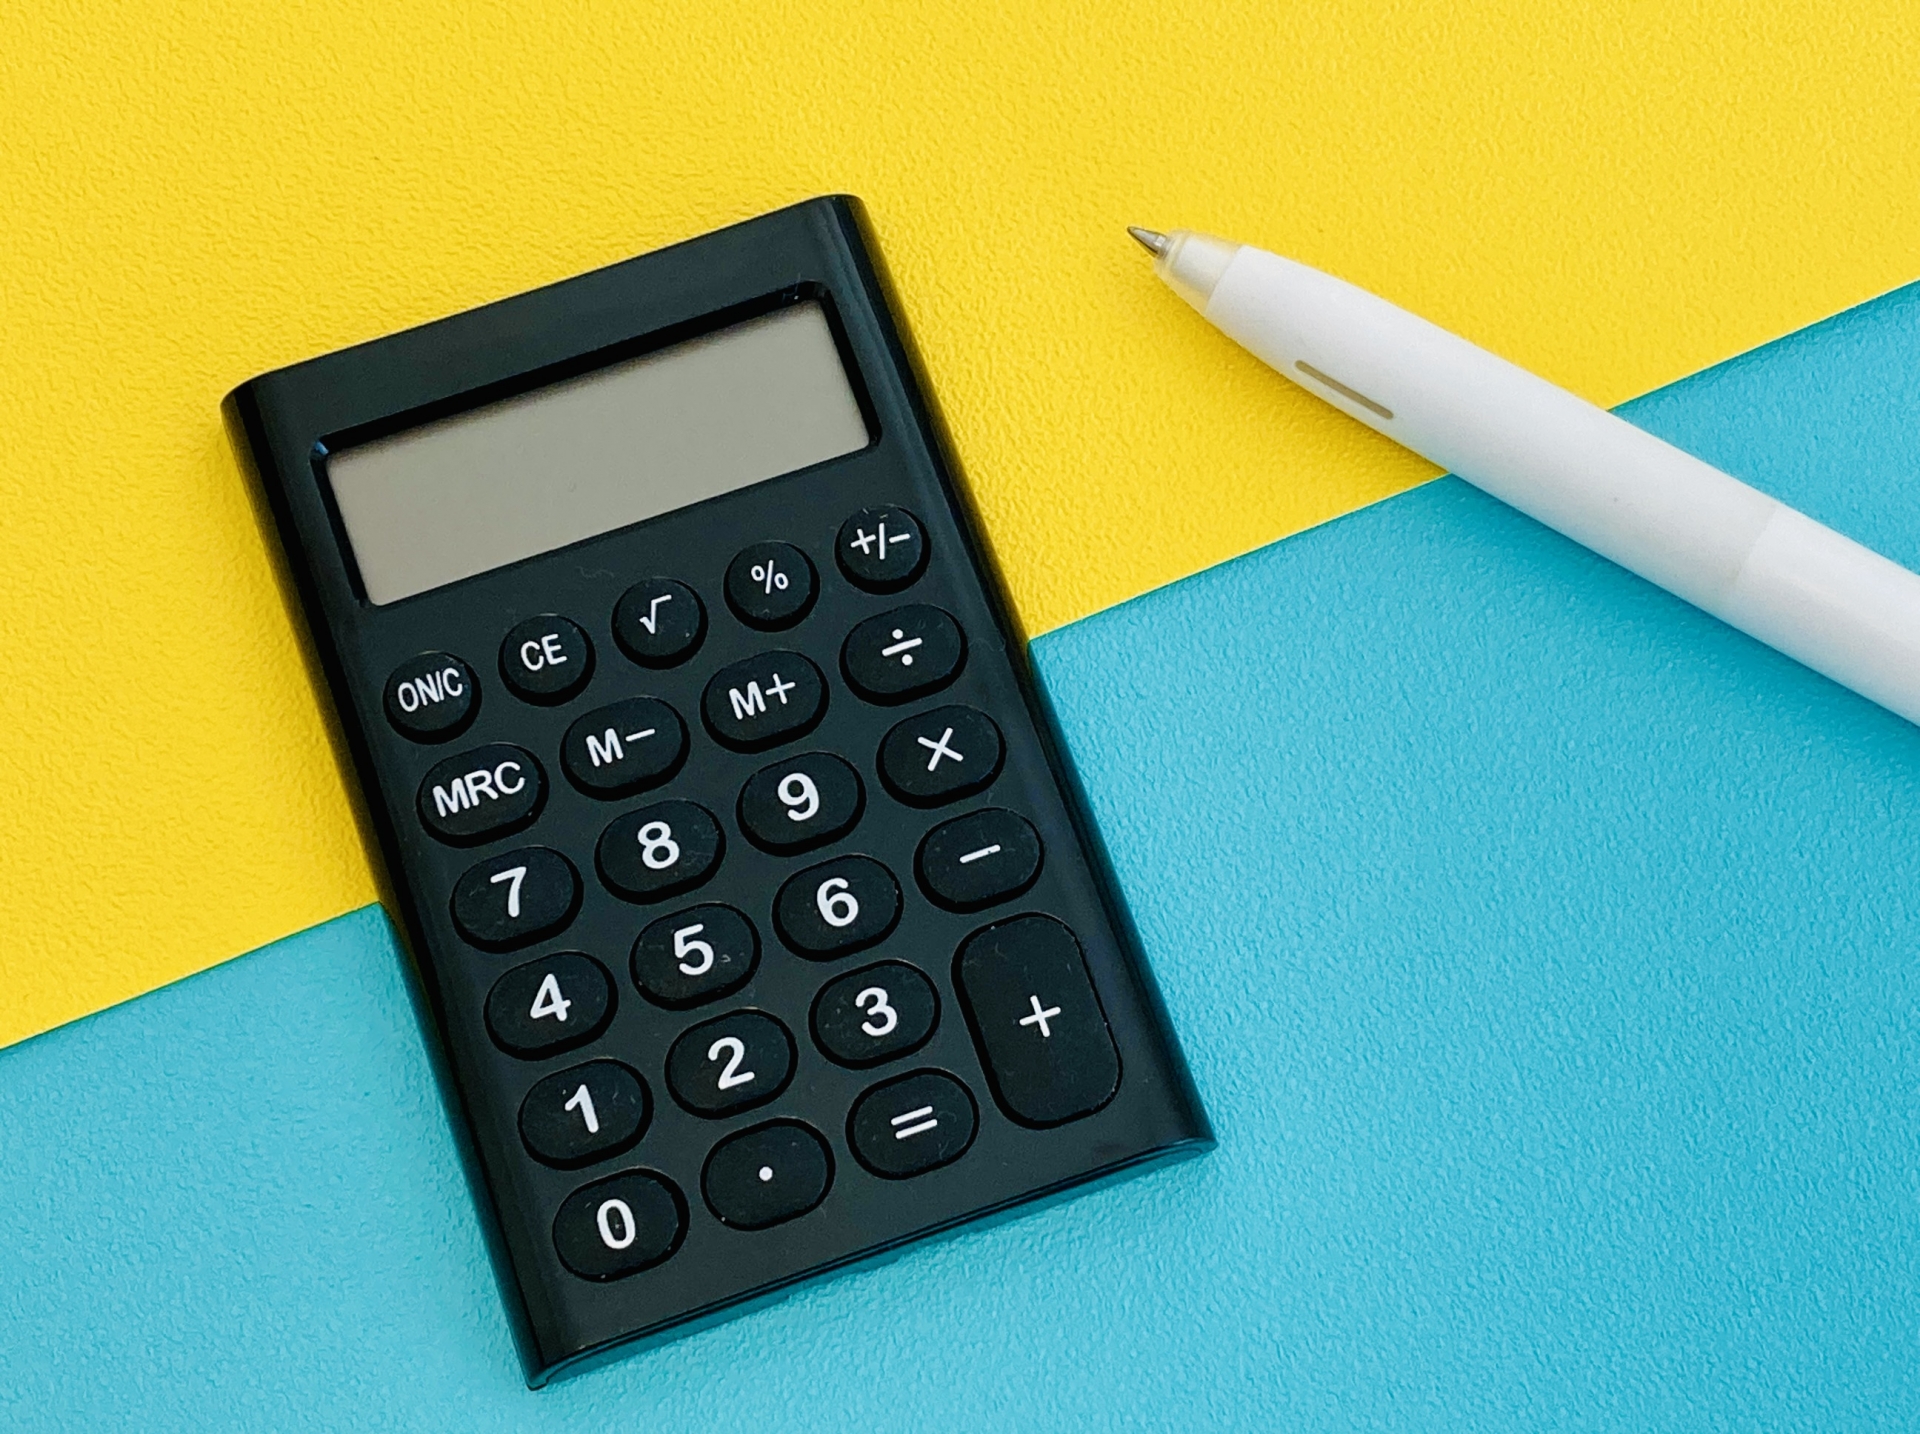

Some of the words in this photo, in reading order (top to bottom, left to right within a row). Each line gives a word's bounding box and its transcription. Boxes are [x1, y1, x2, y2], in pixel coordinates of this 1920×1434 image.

[851, 523, 910, 559] +/-
[751, 560, 788, 594] %
[521, 634, 567, 670] CE
[398, 668, 462, 712] ON/C
[729, 674, 795, 719] M+
[433, 762, 525, 817] MRC
[778, 773, 819, 821] 9
[638, 822, 679, 869] 8
[491, 867, 526, 917] 7
[817, 878, 858, 926] 6
[674, 924, 713, 975] 5
[530, 974, 571, 1021] 4
[856, 988, 897, 1036] 3
[1020, 996, 1061, 1037] +
[708, 1037, 754, 1089] 2
[565, 1085, 599, 1133] 1
[891, 1106, 937, 1139] =
[597, 1199, 635, 1249] 0
